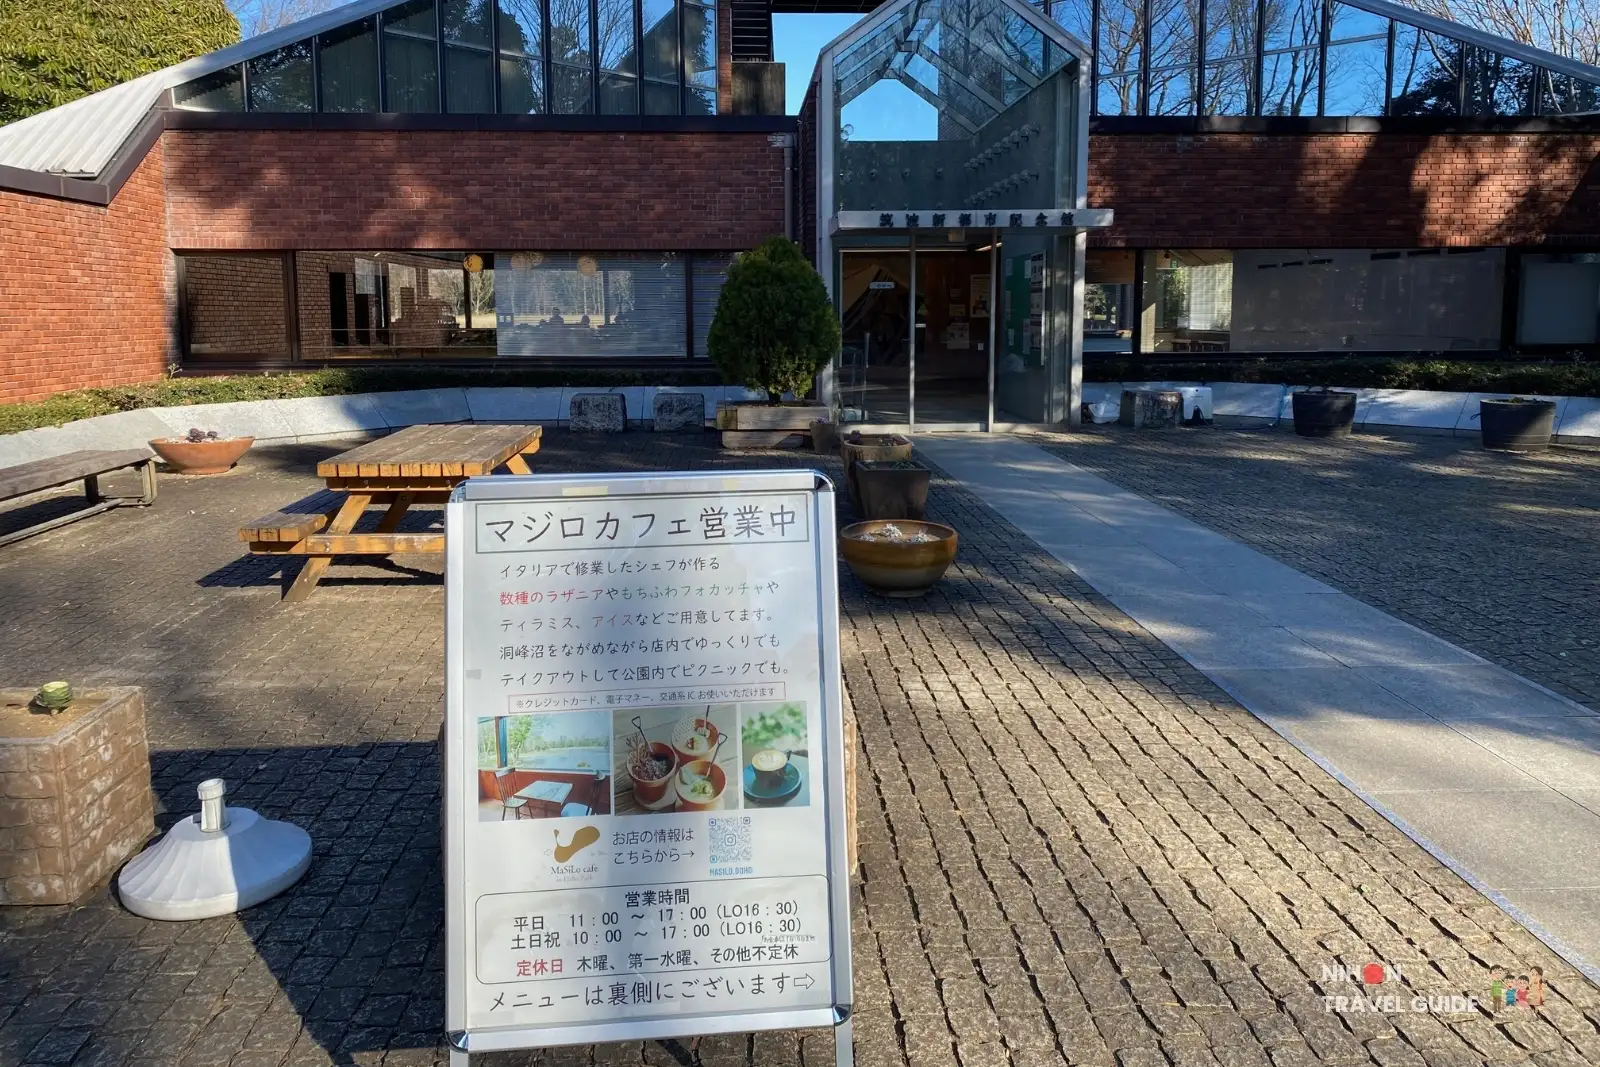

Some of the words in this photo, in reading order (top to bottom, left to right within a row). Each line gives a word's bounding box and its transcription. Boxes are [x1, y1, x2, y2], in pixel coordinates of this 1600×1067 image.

[485, 504, 797, 543] マジロカフェ営業中
[500, 557, 720, 578] イタリアで修業したシェフが作る
[500, 581, 779, 605] 数種のラザニアやもちふわフォカッチャや
[500, 608, 772, 632] ティラミス、アイスなどご用意してます。
[500, 634, 780, 660] 洞峰沼をながめながら店内でゆっくりでも
[500, 661, 788, 687] テイクアウトして公園内でピクニックでも。
[612, 828, 695, 846] お店の情報は
[583, 864, 599, 873] cafe
[625, 888, 690, 908] 営業時間
[514, 916, 544, 932] 平日
[511, 932, 560, 949] 土日祝
[516, 958, 563, 977] 定休日
[489, 972, 790, 1012] メニューは裏側にございます
